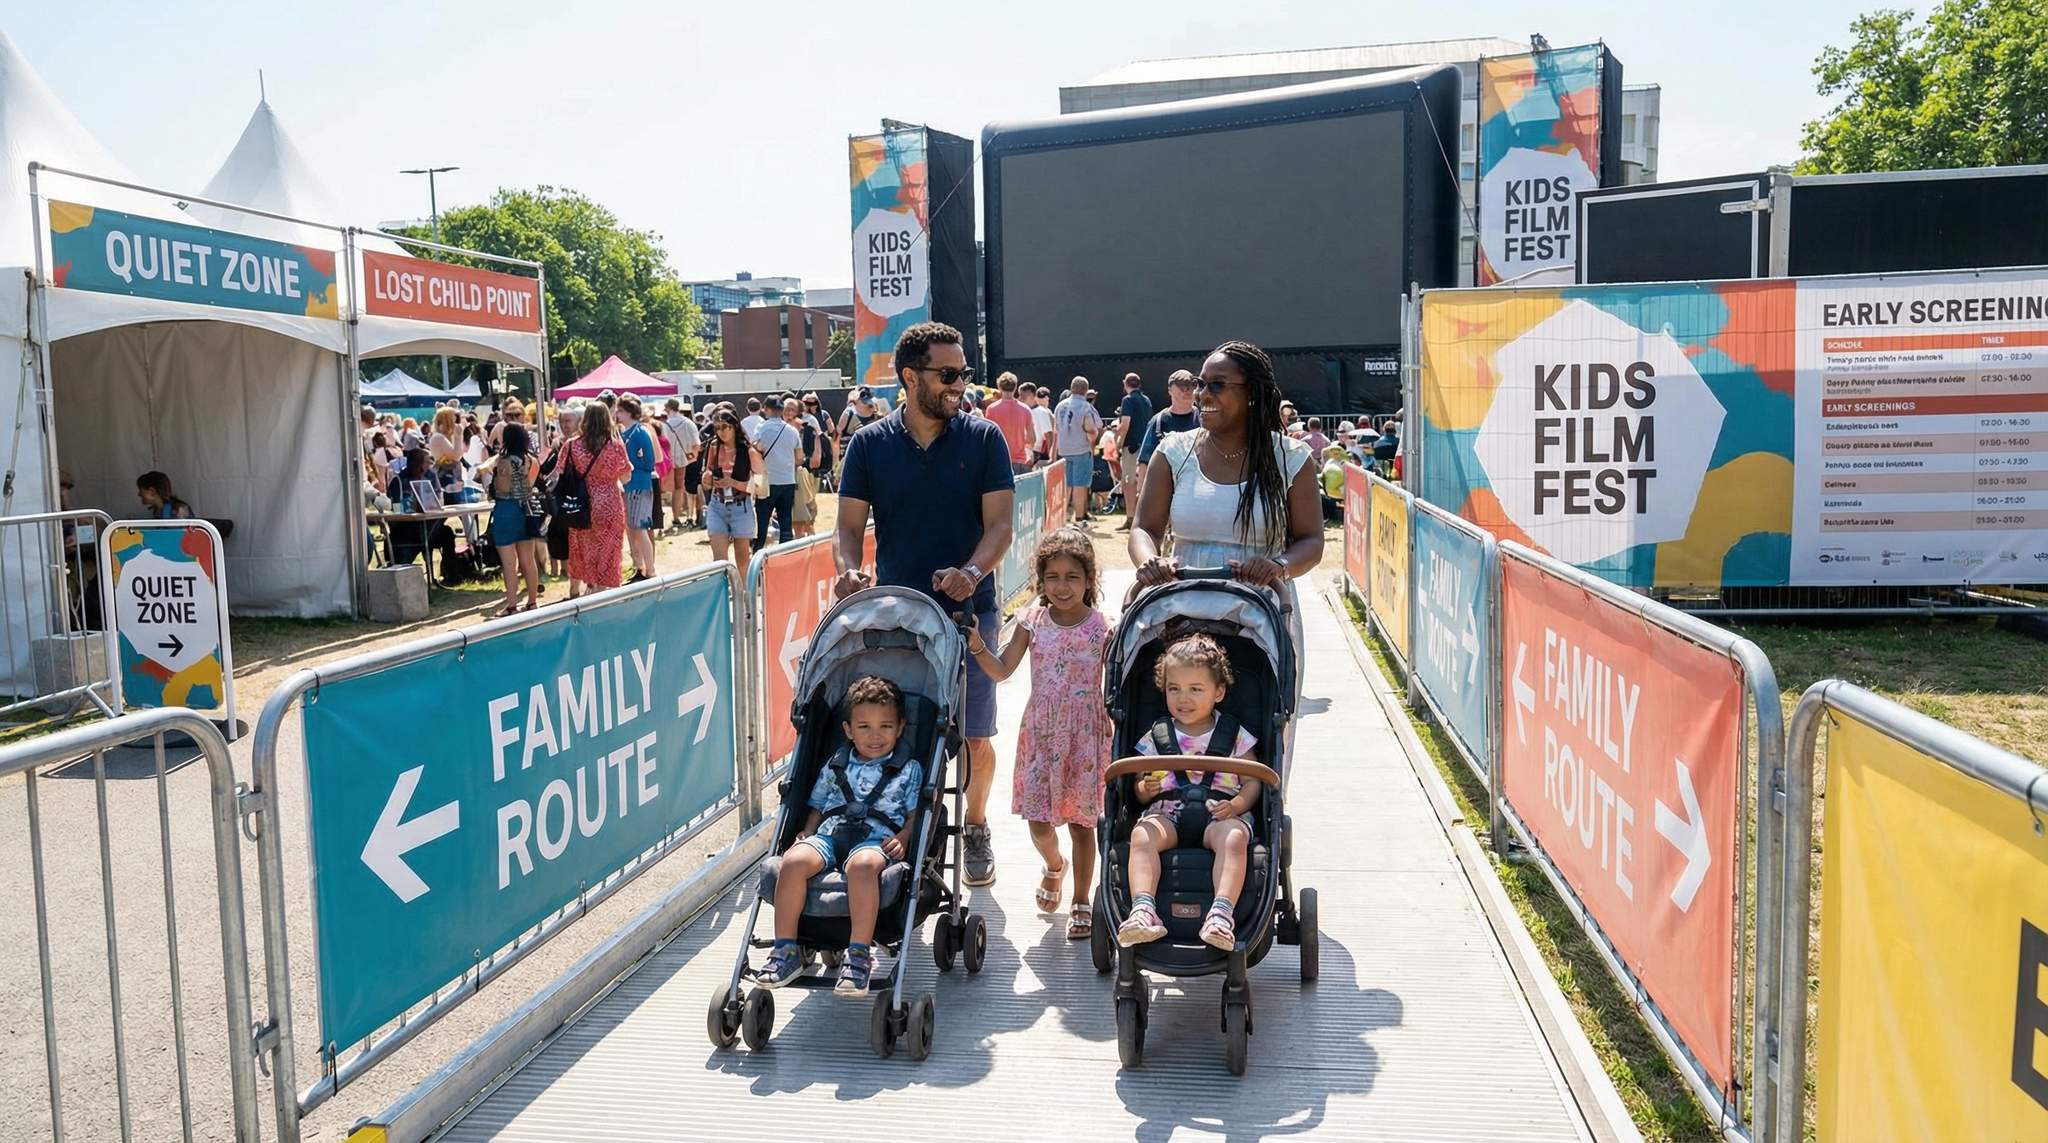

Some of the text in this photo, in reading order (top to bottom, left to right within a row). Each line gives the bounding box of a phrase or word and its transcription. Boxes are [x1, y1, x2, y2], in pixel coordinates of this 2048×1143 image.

[1506, 176, 1570, 206] KIDS
[869, 230, 911, 254] KIDS
[1505, 206, 1569, 234] FILM
[106, 230, 301, 298] QUIET ZONE
[869, 254, 912, 276] FILM
[1505, 234, 1571, 262] FEST
[374, 269, 532, 318] LOST CHILD POINT
[870, 276, 912, 298] FEST
[1823, 296, 2048, 326] EARLY SCREENIN
[1534, 362, 1656, 410] KIDS
[1827, 402, 1916, 412] EARLY SCREENINGS
[1535, 416, 1655, 463] FILM
[1534, 469, 1657, 515] FEST
[132, 576, 196, 601] QUIET
[1429, 549, 1462, 621] FAMILY
[137, 602, 197, 624] ZONE
[1428, 611, 1458, 694] ROUTE
[488, 642, 656, 782] FAMILY
[1544, 627, 1641, 774] FAMILY
[497, 731, 659, 890] ROUTE
[1544, 725, 1634, 901] ROUTE
